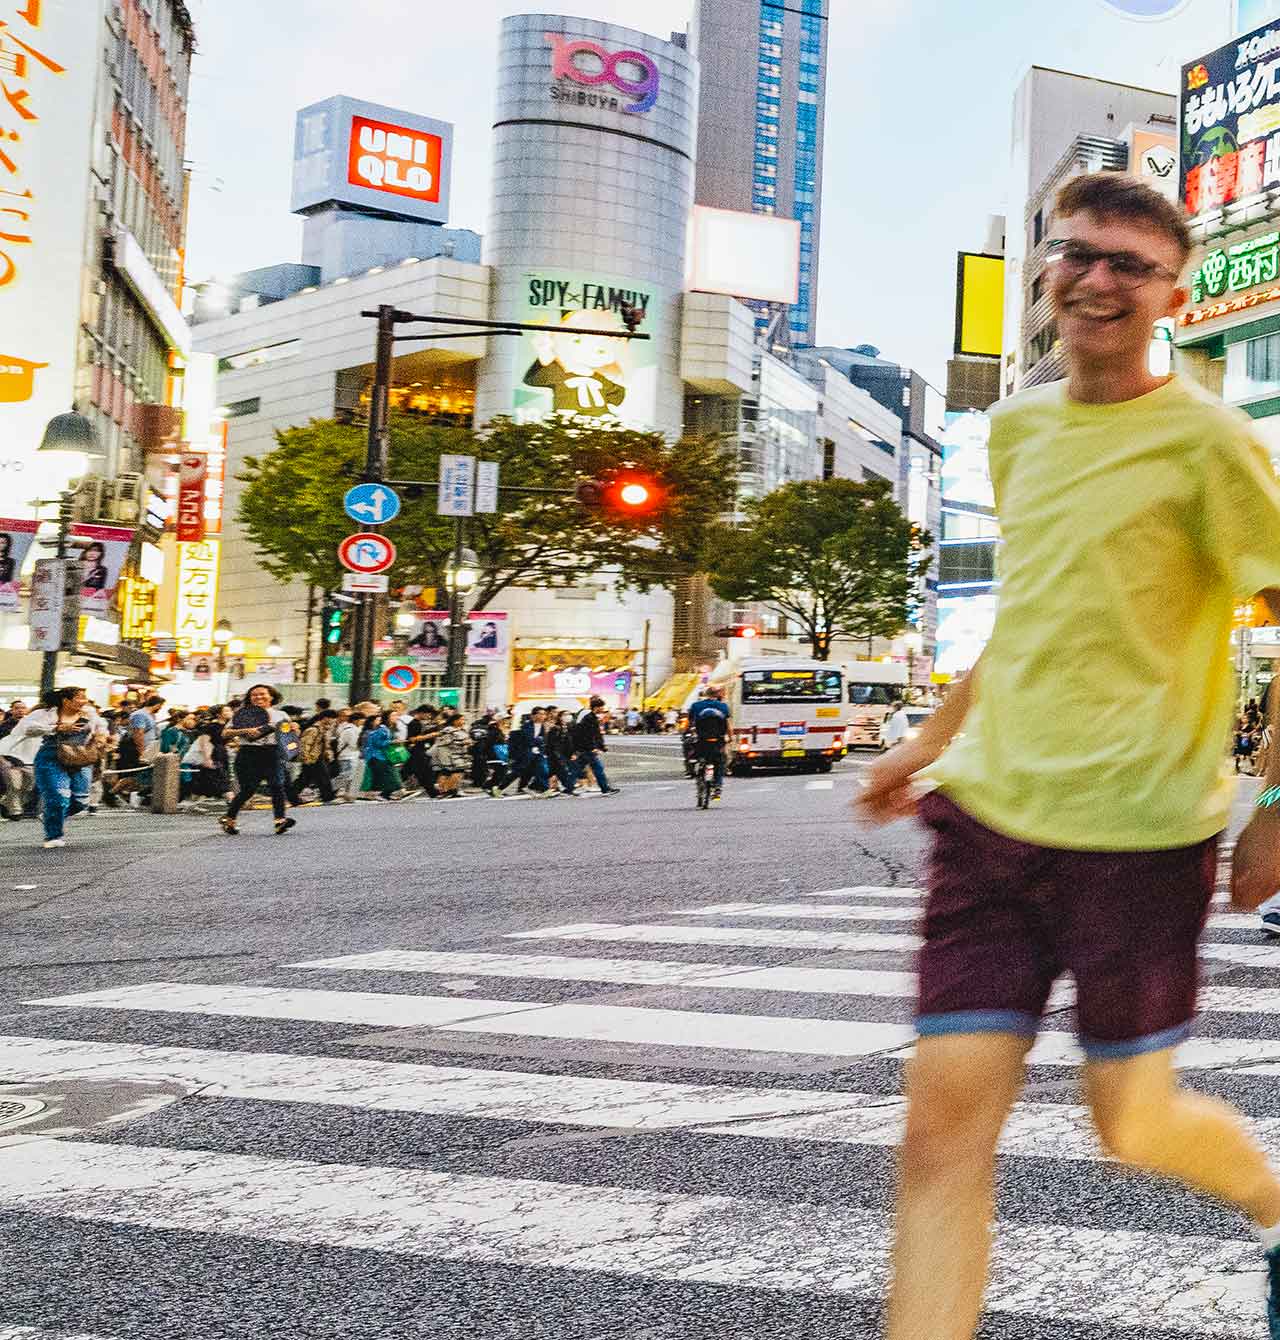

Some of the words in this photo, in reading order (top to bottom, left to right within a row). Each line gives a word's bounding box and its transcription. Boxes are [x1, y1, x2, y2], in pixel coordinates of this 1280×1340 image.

[543, 32, 660, 112] 109
[549, 86, 619, 112] SHIBUYA
[359, 126, 427, 164] UNI
[357, 155, 432, 191] QLO
[1228, 246, 1280, 292] 西村
[182, 541, 214, 630] 処方せん
